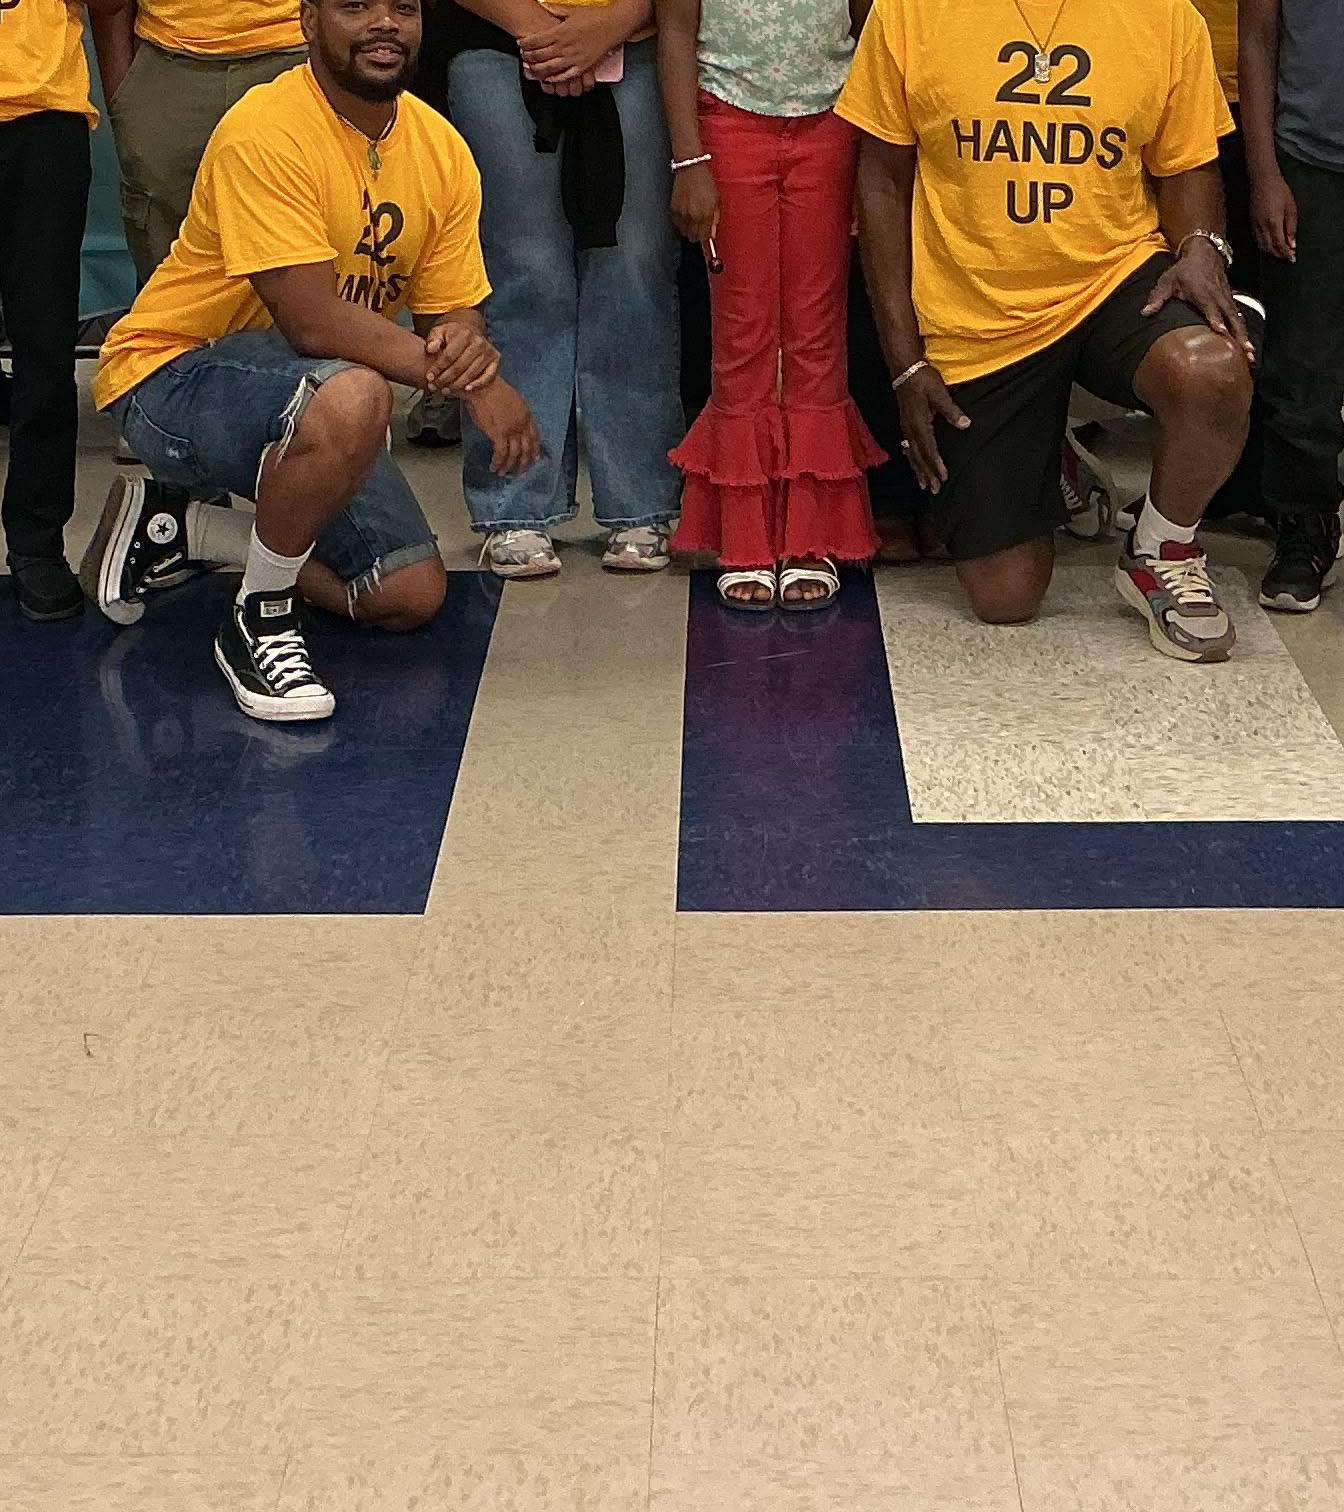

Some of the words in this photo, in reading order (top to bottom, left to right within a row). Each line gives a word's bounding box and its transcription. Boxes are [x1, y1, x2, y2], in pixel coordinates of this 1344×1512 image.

[995, 41, 1092, 107] 22
[952, 119, 1127, 171] HANDS
[1006, 181, 1074, 224] UP
